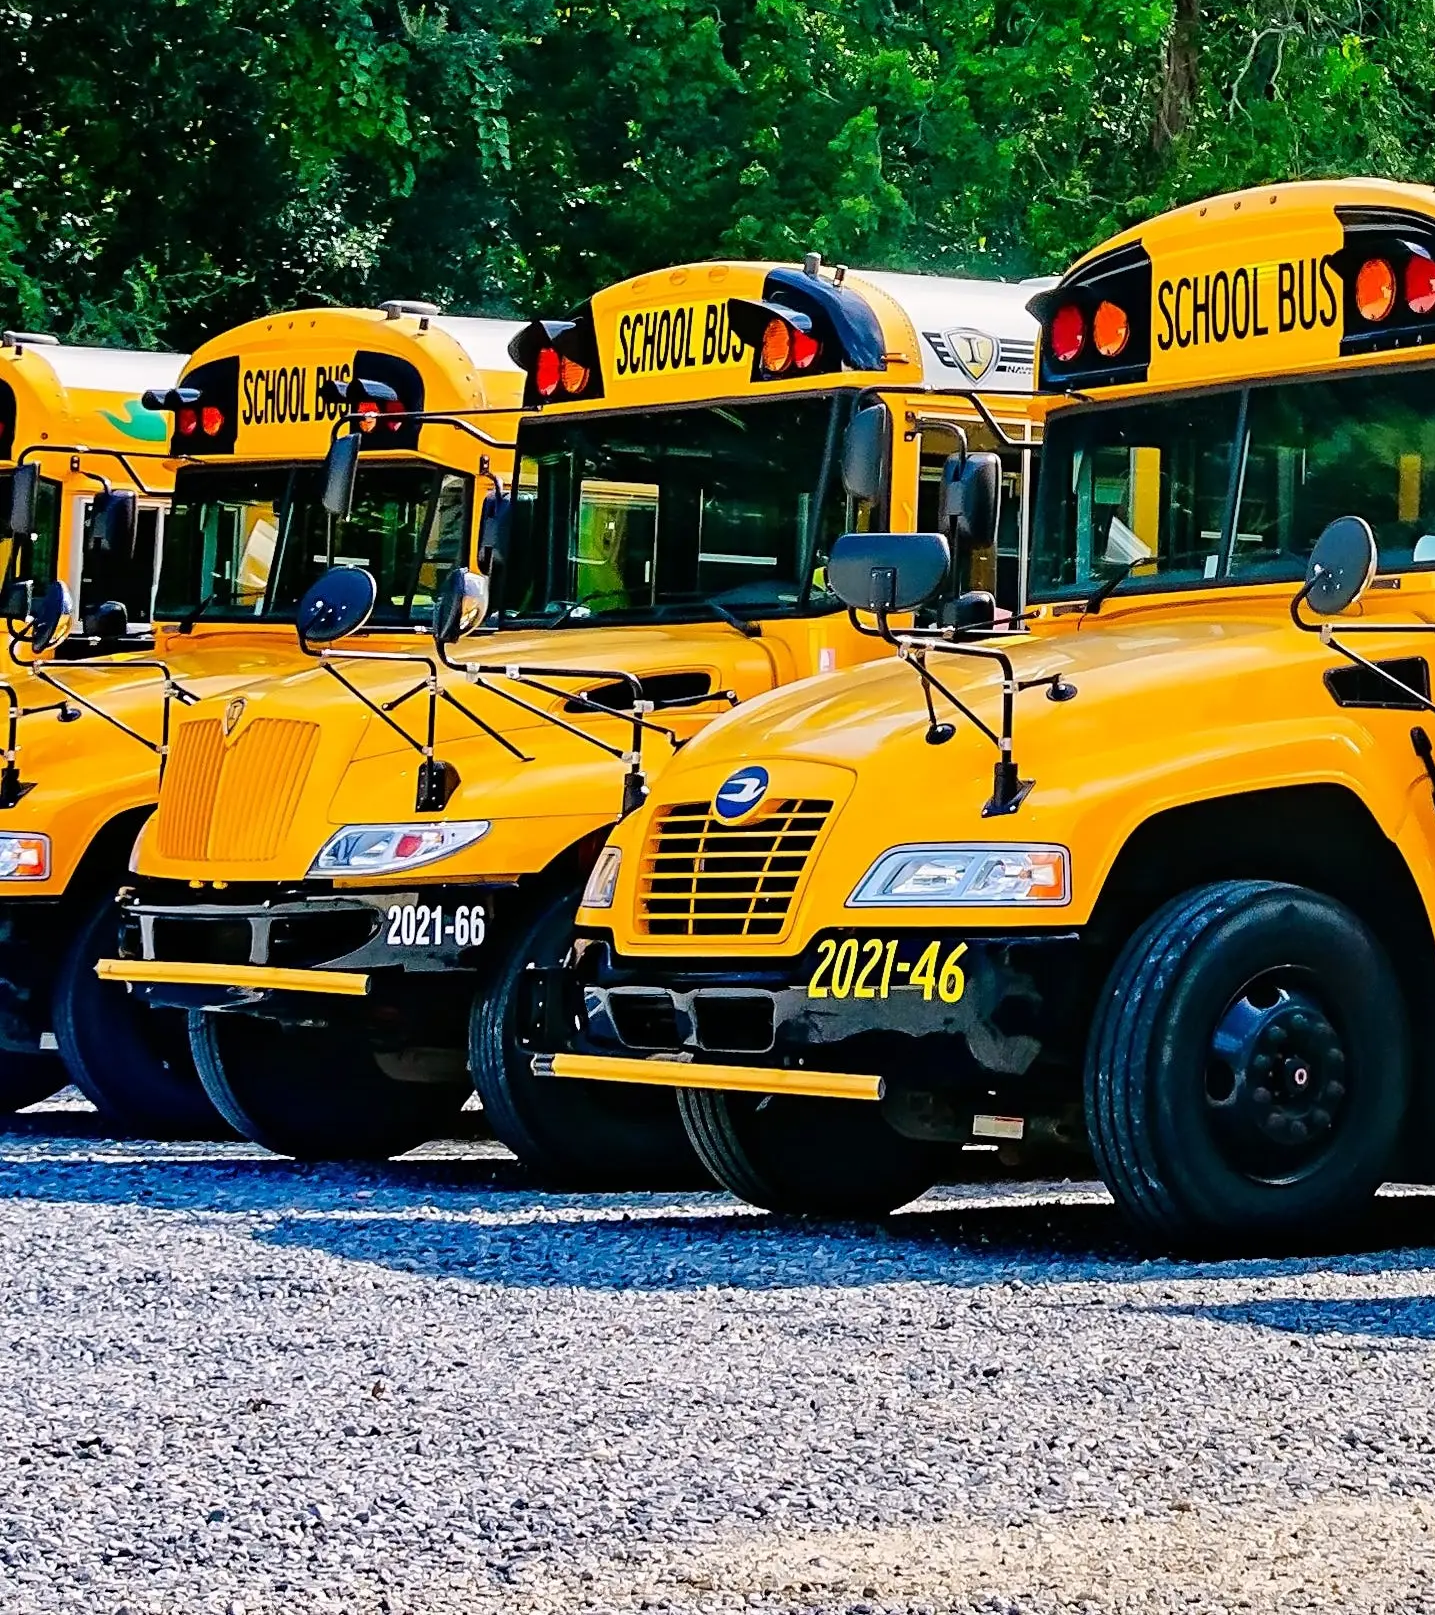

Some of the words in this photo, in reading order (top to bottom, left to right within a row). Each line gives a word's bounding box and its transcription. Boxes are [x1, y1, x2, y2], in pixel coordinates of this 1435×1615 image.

[1157, 267, 1269, 351] SCHOOL
[1278, 254, 1337, 333] BUS
[616, 307, 696, 376] SCHOOL
[242, 366, 310, 426] SCHOOL
[386, 904, 486, 946] 2021-66
[807, 938, 969, 1003] 2021-46
